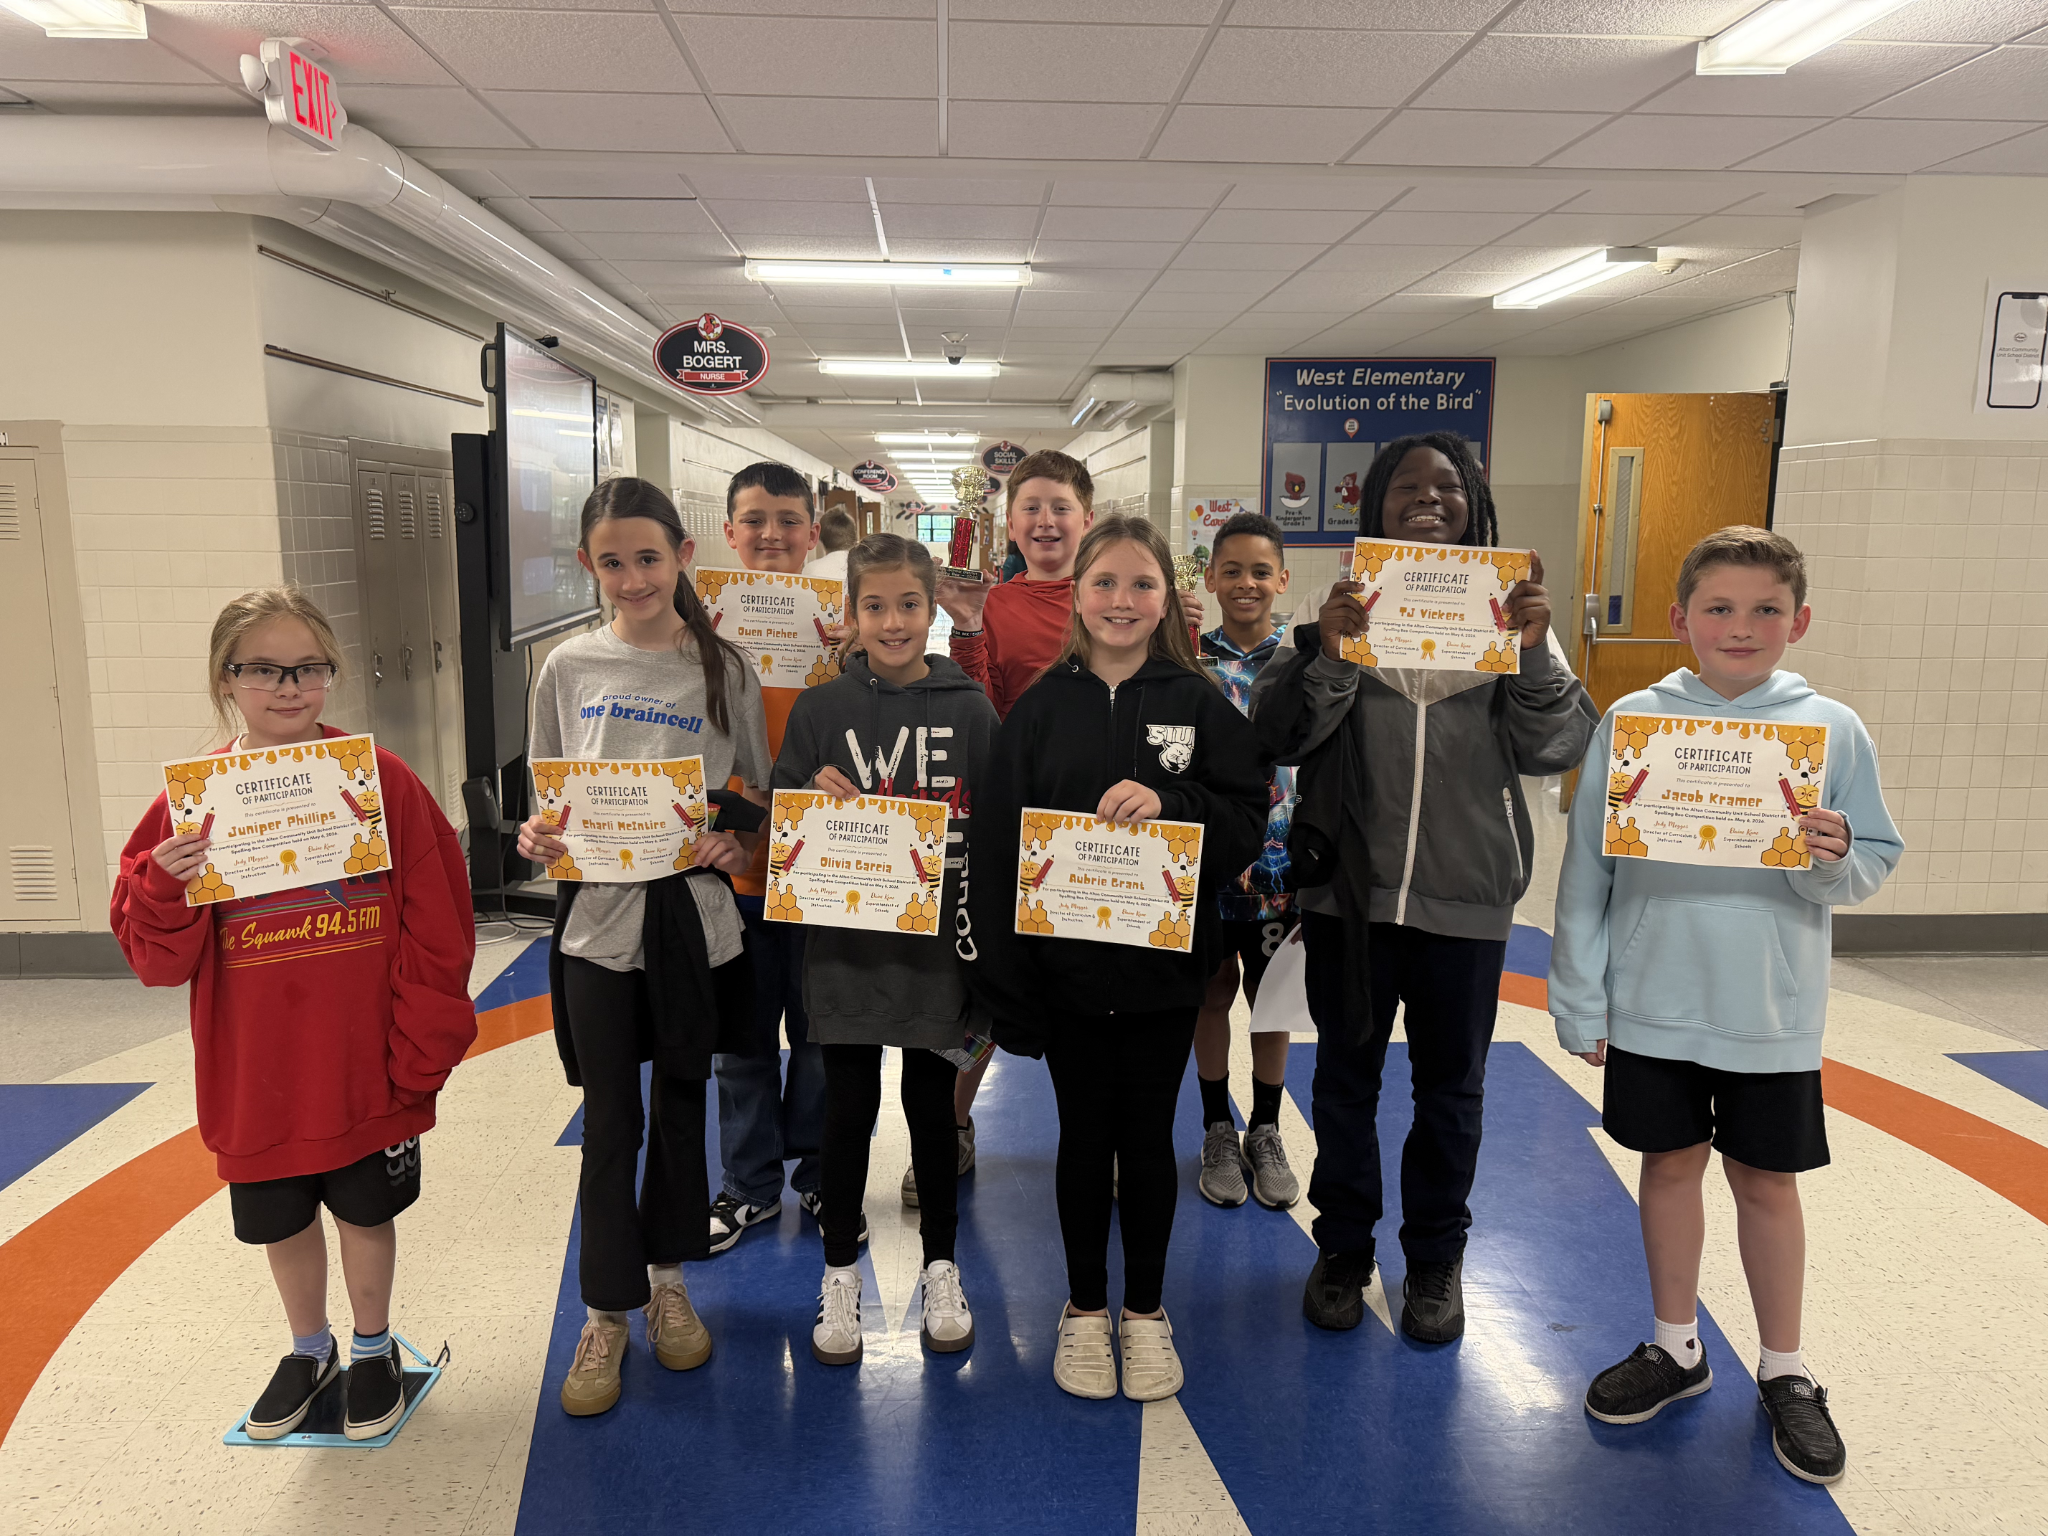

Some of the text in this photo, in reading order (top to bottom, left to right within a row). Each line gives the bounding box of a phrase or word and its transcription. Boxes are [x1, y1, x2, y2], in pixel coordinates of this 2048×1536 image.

[290, 51, 333, 141] EXIT
[694, 341, 730, 353] MRS.
[683, 356, 742, 368] BOGERT
[1297, 368, 1466, 390] West Elementary
[1376, 393, 1396, 410] of
[1400, 394, 1430, 410] the
[1210, 500, 1232, 512] West
[1404, 572, 1469, 585] CERTIFICATE
[1416, 584, 1467, 594] PARTICIPATION
[741, 595, 795, 607] CERTIFICATE
[752, 606, 794, 615] PARTICIPATION
[1400, 607, 1465, 621] TJ Vickers
[738, 627, 762, 636] Owen
[635, 695, 663, 705] owner
[581, 702, 703, 734] one braincell
[1146, 725, 1195, 746] SIU
[846, 726, 955, 789] WE
[1674, 748, 1752, 764] CERTIFICATE
[1678, 762, 1751, 774] OF PARTICIPATION
[236, 773, 312, 796] CERTIFICATE
[242, 787, 313, 805] OF PARTICIPATION
[587, 786, 648, 797] CERTIFICATE
[1662, 789, 1762, 807] Jacob Kramer
[601, 798, 648, 806] PARTICIPATION
[254, 808, 280, 816] certificate
[286, 803, 310, 812] presented
[1654, 810, 1674, 818] Spelling
[228, 811, 336, 838] Juniper Phillips
[582, 819, 666, 831] Charli McIntire
[826, 820, 890, 836] CERTIFICATE
[219, 841, 251, 852] participating
[280, 832, 306, 841] Community
[231, 846, 251, 855] Spelling
[262, 840, 292, 851] Competition
[310, 834, 320, 842] May
[839, 834, 888, 844] PARTICIPATION
[1075, 841, 1140, 858] CERTIFICATE
[304, 851, 337, 862] Superintendent
[1088, 855, 1139, 866] PARTICIPATION
[224, 868, 244, 876] Director
[251, 863, 275, 872] Curriculum
[820, 857, 892, 873] Olivia Garcia
[241, 871, 266, 879] Instruction
[1069, 874, 1145, 890] Aubrie Grant
[220, 927, 236, 950] The
[241, 915, 312, 950] Squawk
